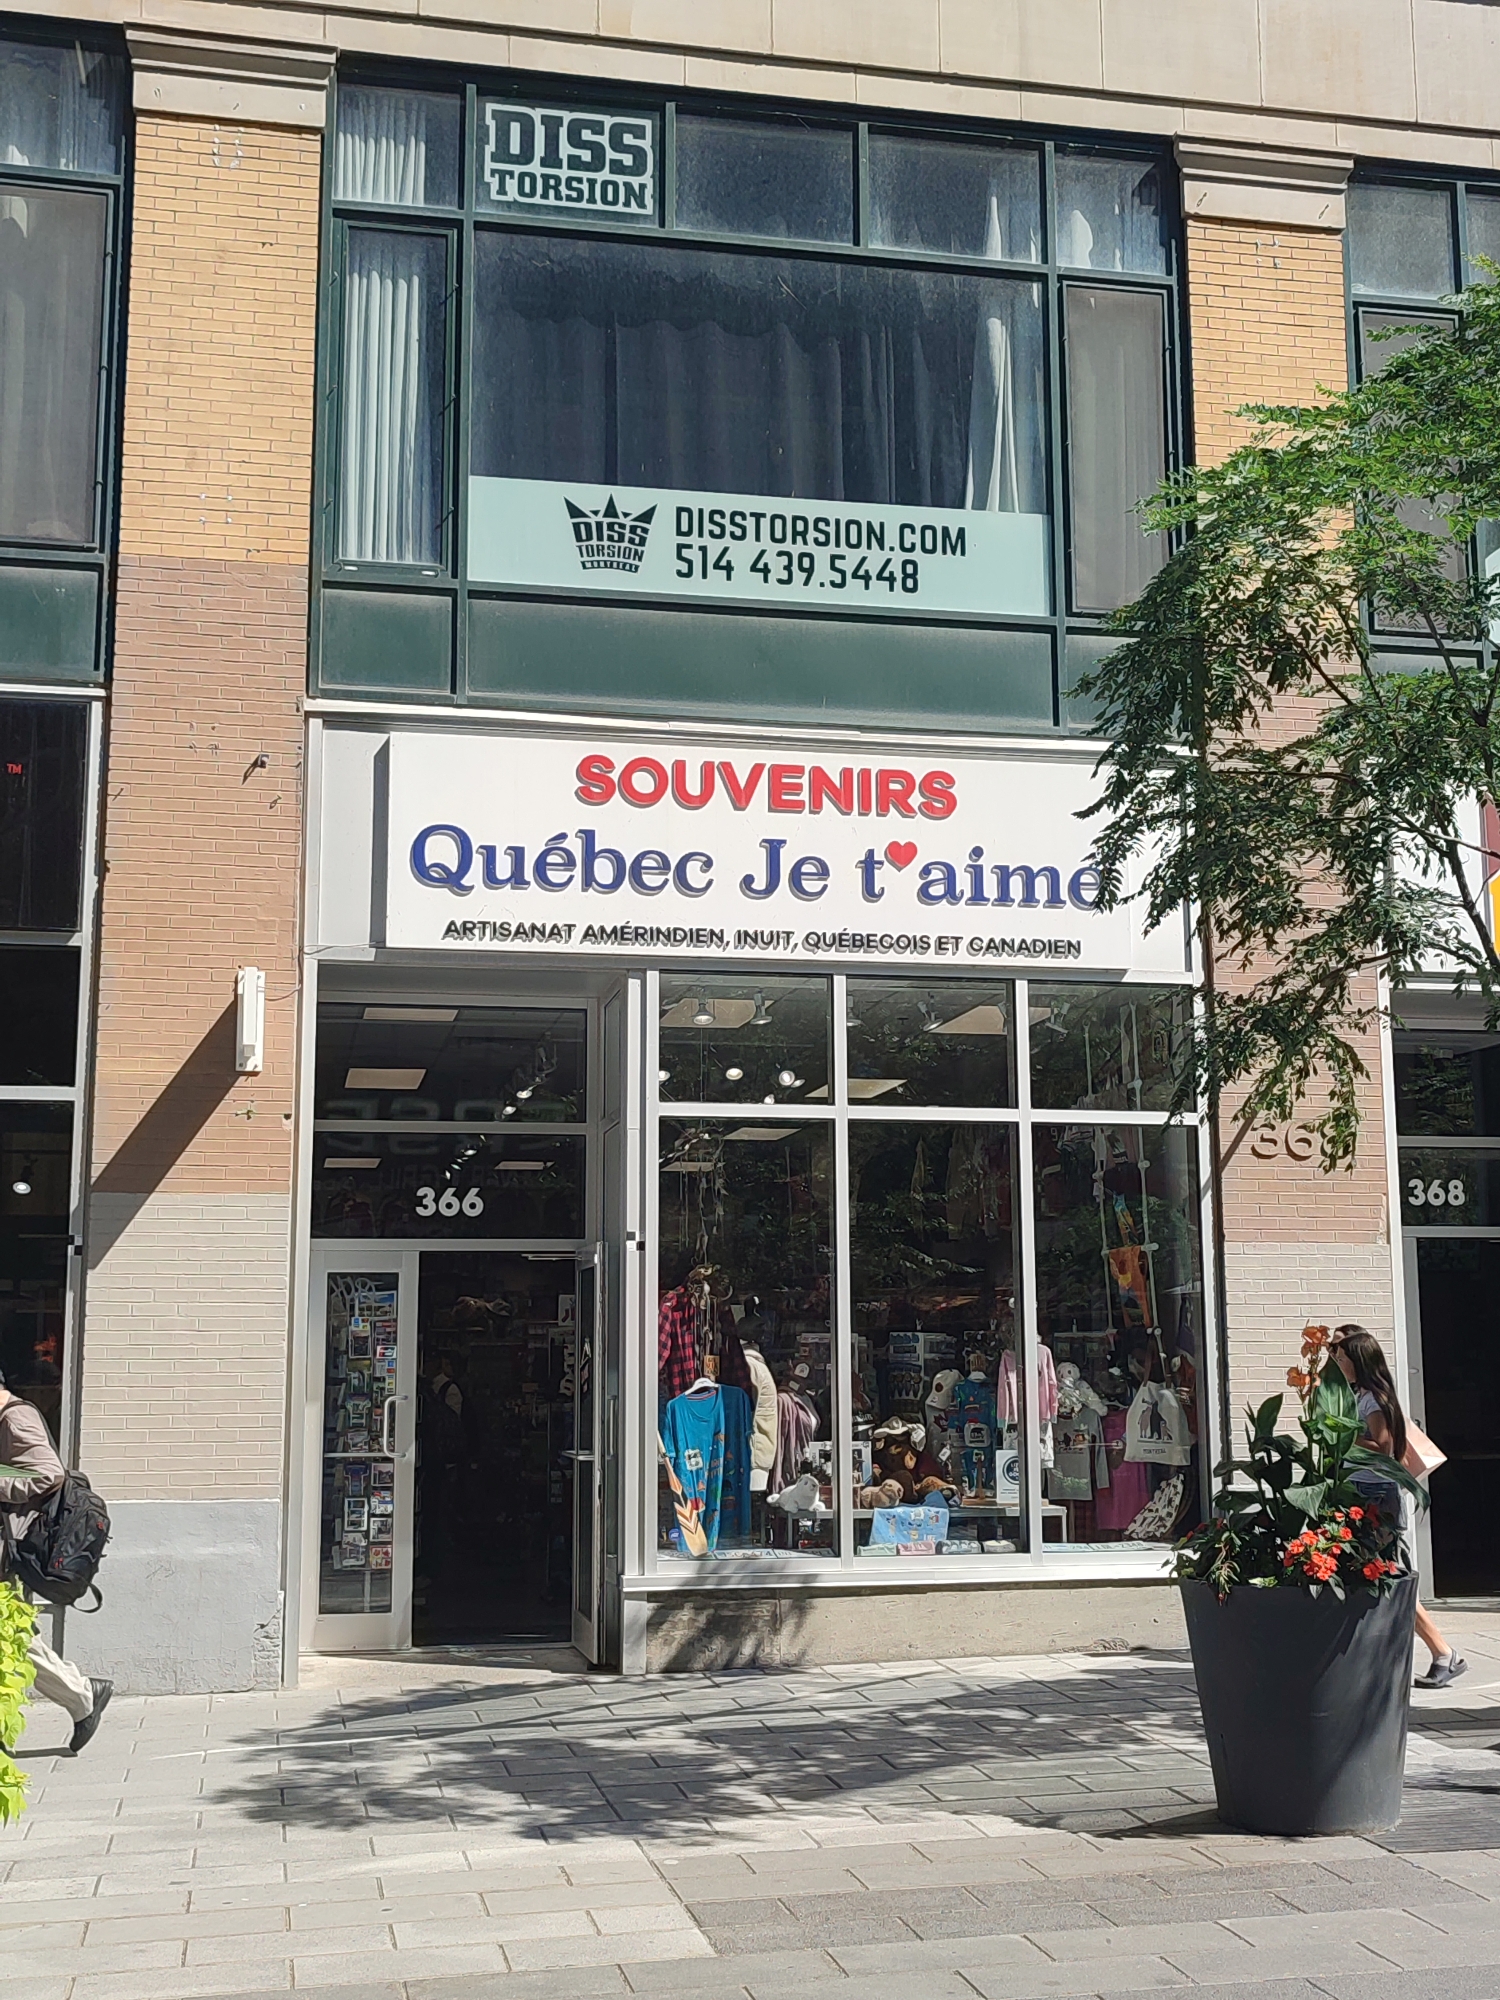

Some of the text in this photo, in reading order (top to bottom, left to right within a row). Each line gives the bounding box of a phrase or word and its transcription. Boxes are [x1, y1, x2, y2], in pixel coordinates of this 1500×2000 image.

[490, 108, 648, 178] DISS
[490, 168, 648, 210] TORSION
[571, 521, 650, 548] DISS
[675, 506, 966, 557] DISSTORSION.COM
[576, 544, 645, 563] TORSION
[584, 560, 637, 572] MONTREAL
[675, 543, 919, 594] 514 439.5448
[576, 754, 957, 819] SOUVENIRS
[410, 824, 714, 897] Québec
[740, 838, 830, 901] Je
[442, 919, 1081, 958] ARTISANAT AMÉRINDIEN, INUIT, QUÉBECOIS ET CANADIEN
[415, 1187, 484, 1217] 366
[1408, 1178, 1466, 1206] 368
